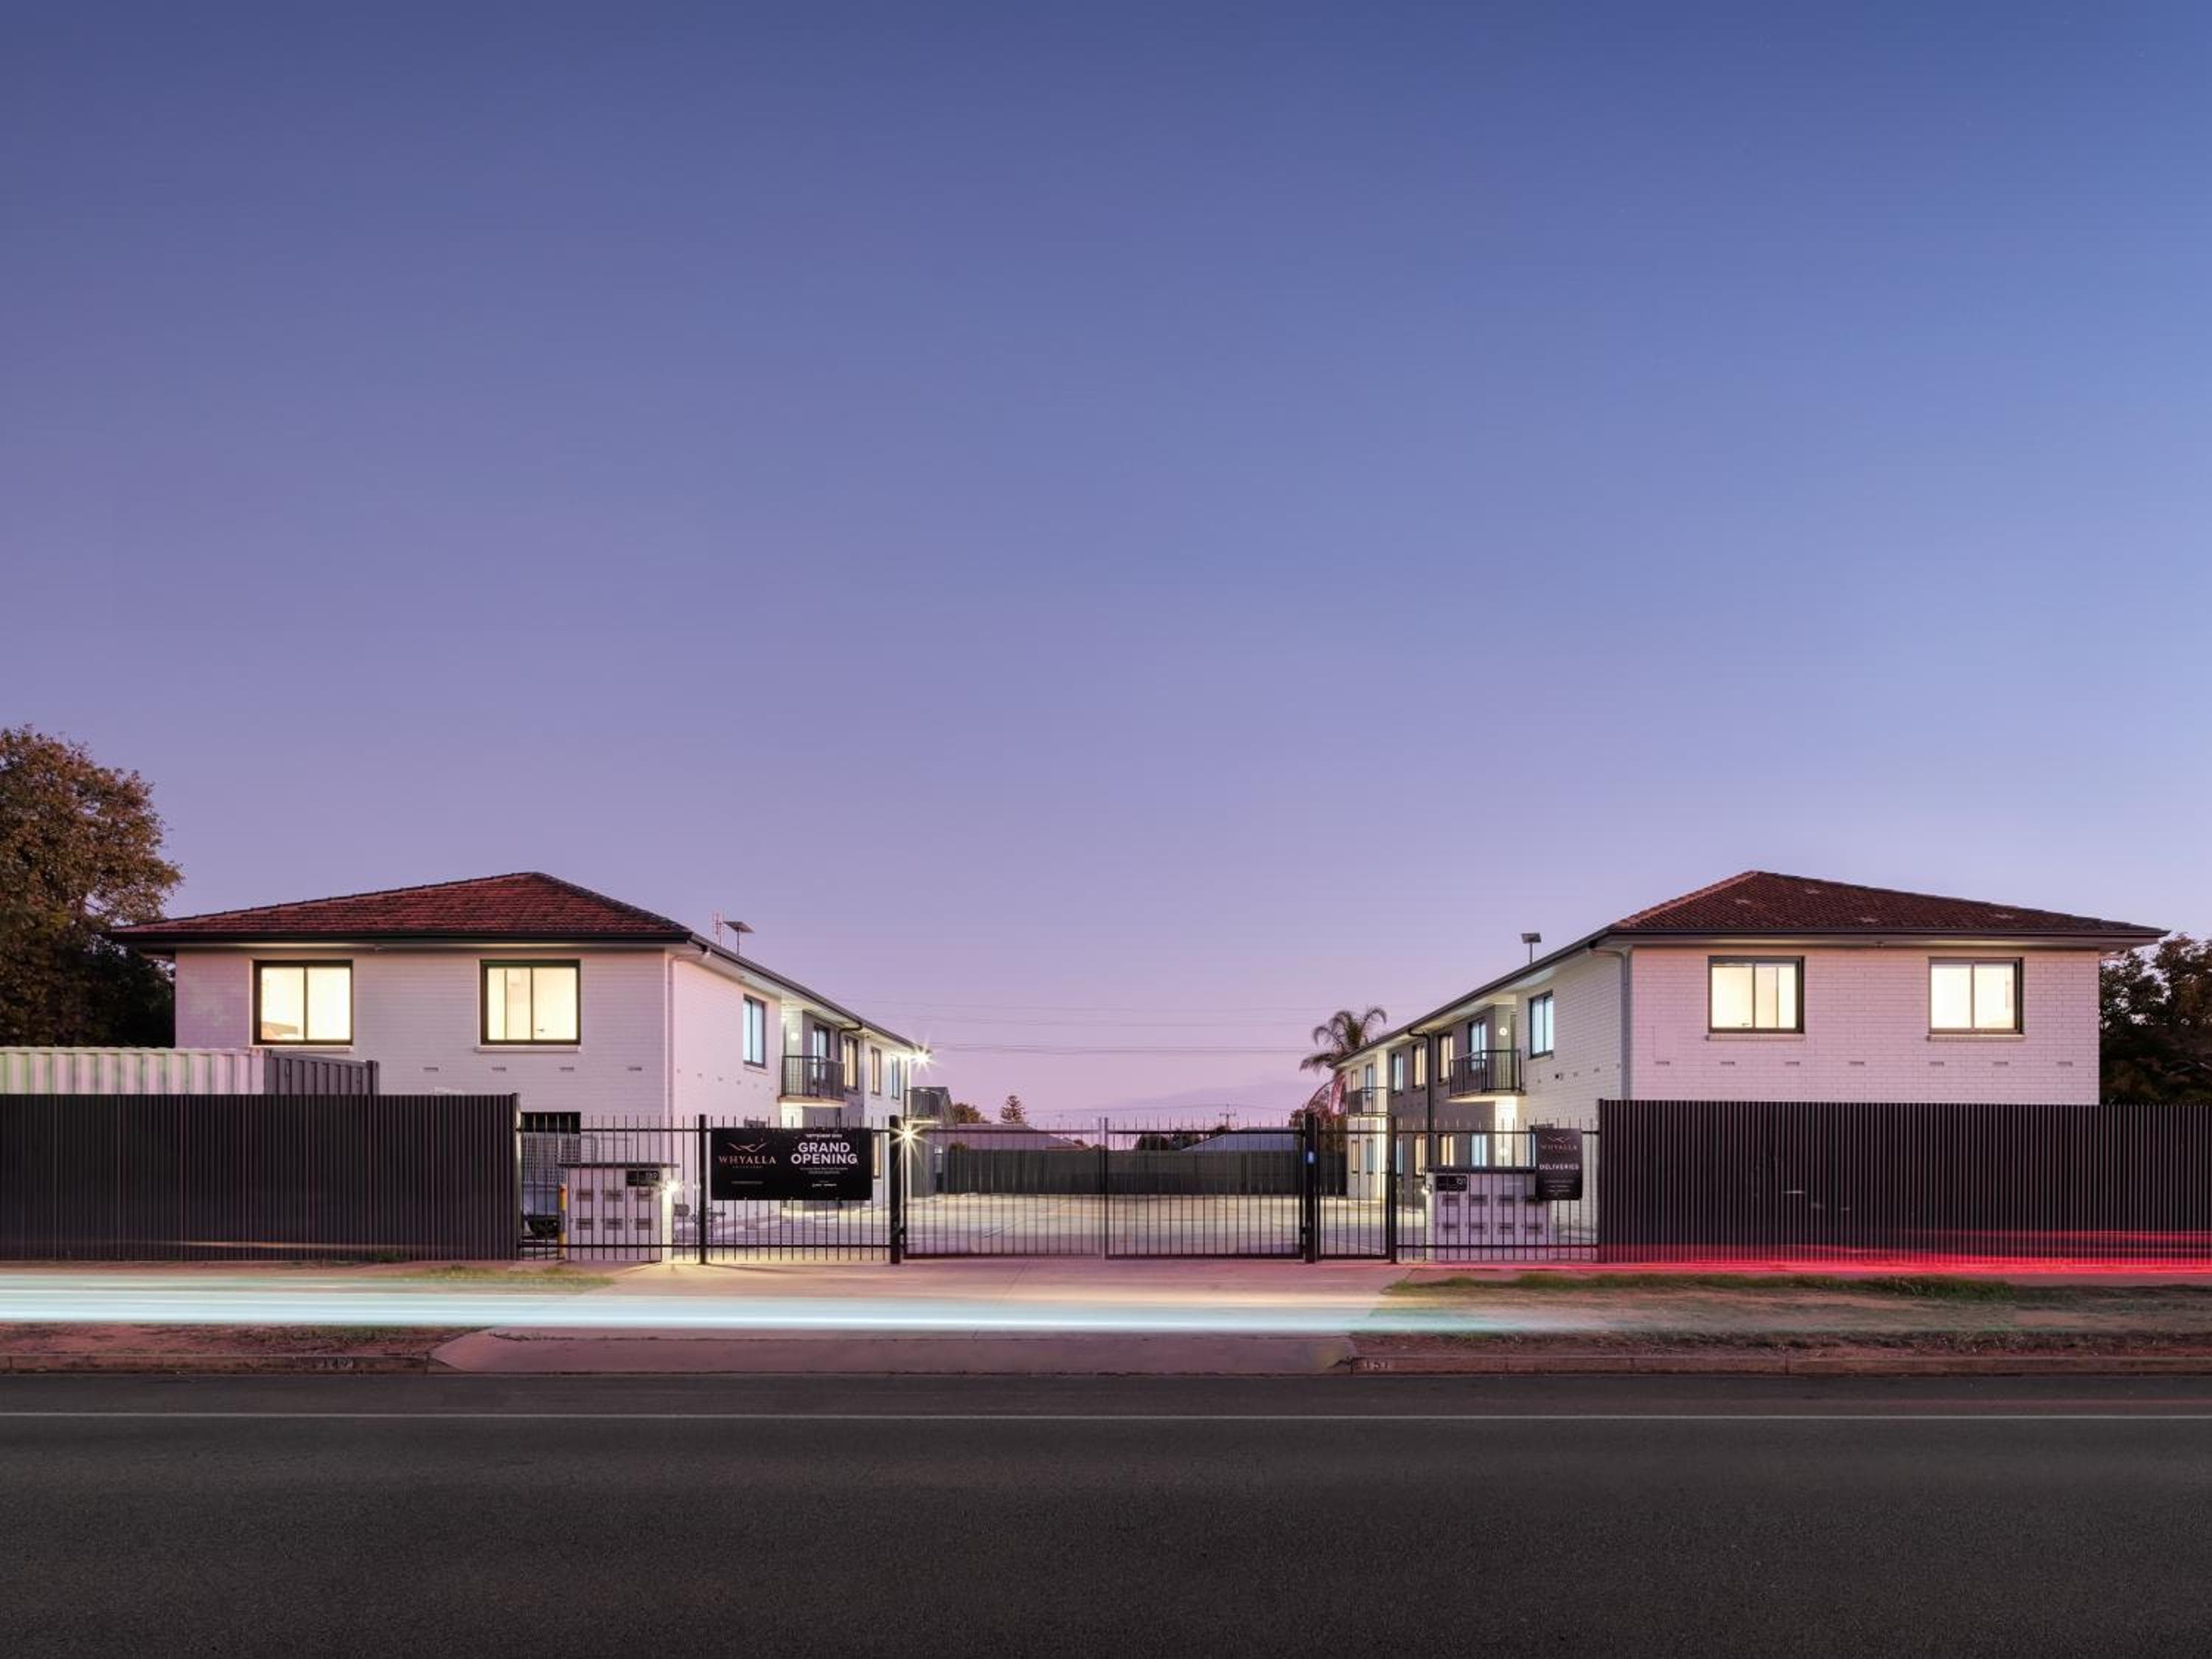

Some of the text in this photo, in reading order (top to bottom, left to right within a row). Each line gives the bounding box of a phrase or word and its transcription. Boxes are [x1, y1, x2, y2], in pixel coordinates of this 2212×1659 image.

[798, 1142, 850, 1153] GRAND
[718, 1155, 776, 1164] WHYALLA
[790, 1153, 858, 1165] OPENING
